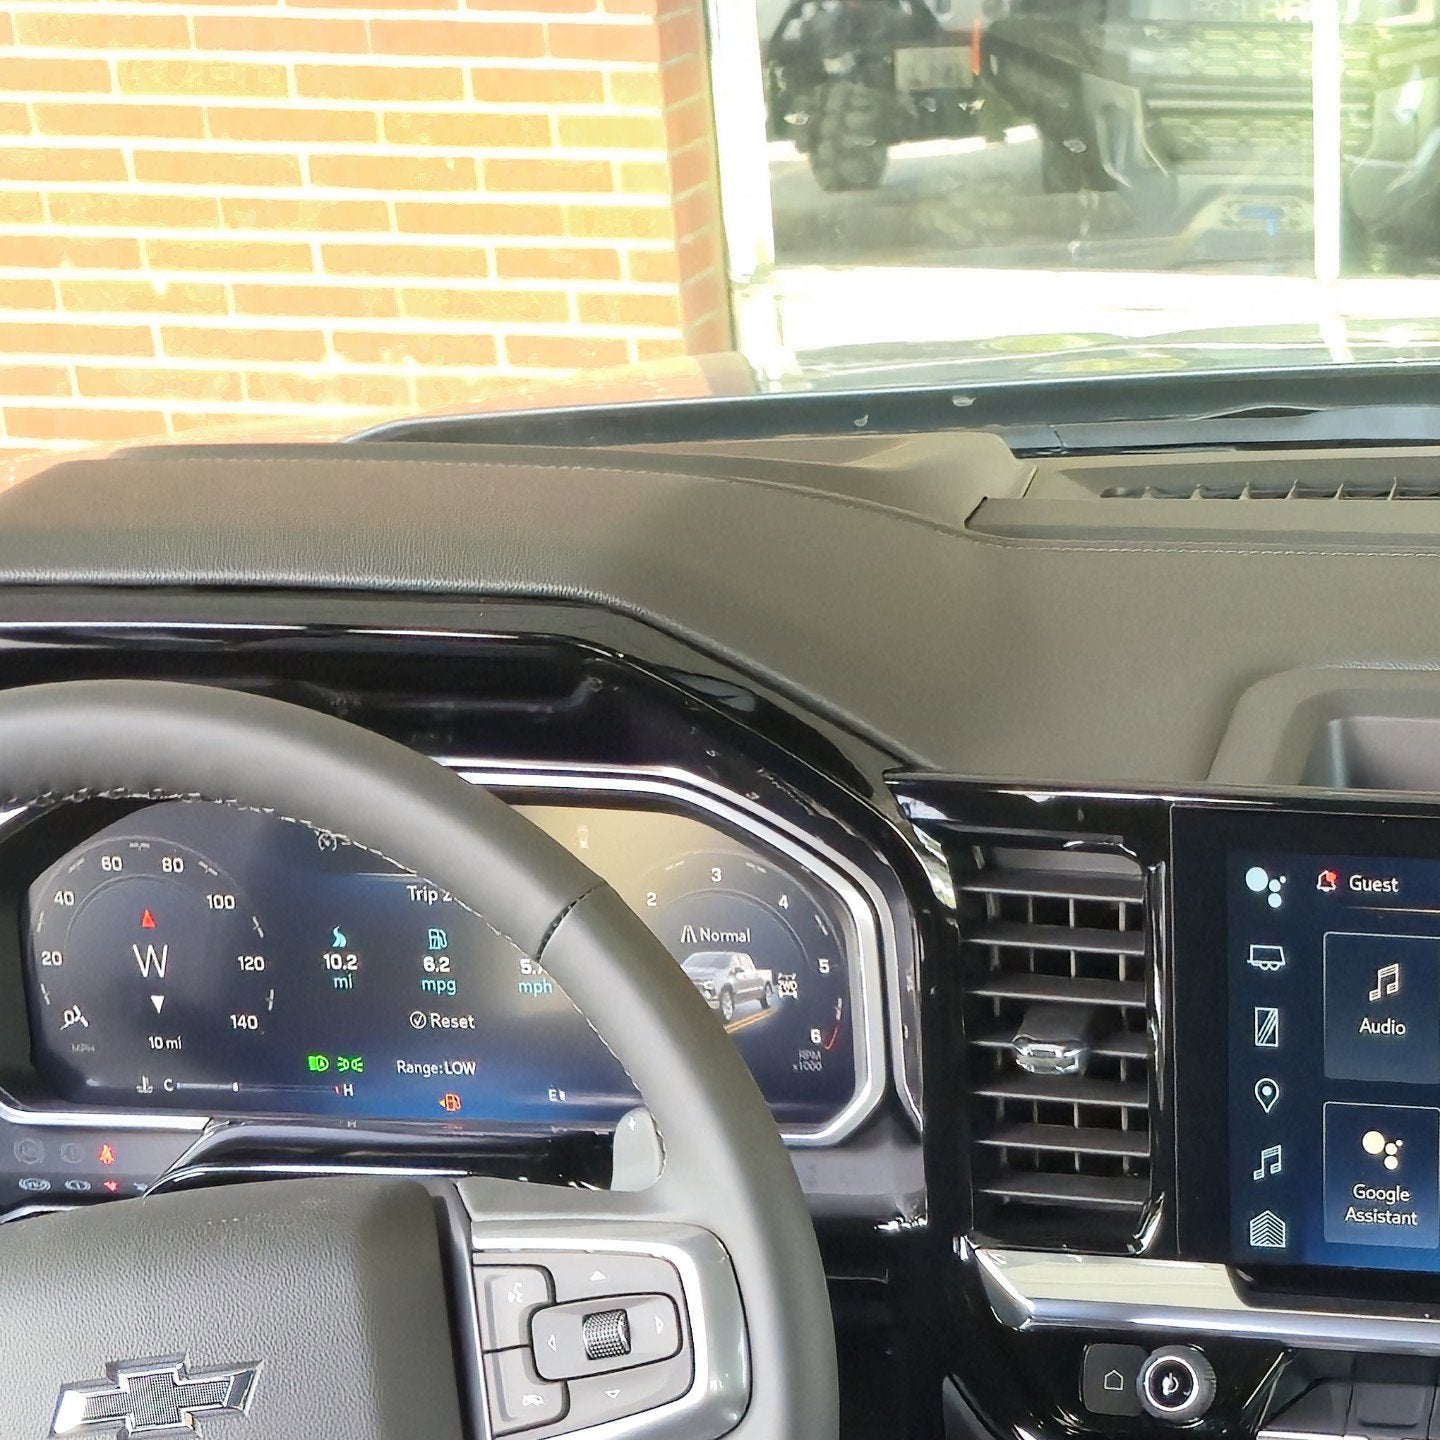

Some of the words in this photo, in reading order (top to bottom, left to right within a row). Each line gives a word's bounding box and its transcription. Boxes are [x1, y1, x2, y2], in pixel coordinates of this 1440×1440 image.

[101, 856, 122, 871] 60
[162, 857, 183, 873] 80
[711, 867, 721, 882] 3
[1349, 874, 1399, 892] Guest
[54, 890, 74, 905] 40
[207, 894, 235, 910] 100
[407, 885, 438, 905] Trip
[646, 892, 657, 907] 2
[778, 894, 789, 909] 4
[700, 928, 750, 943] Normal
[41, 951, 62, 966] 20
[133, 944, 168, 978] W
[238, 956, 265, 971] 120
[323, 953, 358, 970] 10.2
[423, 957, 450, 973] 6.2
[819, 959, 830, 974] 5
[334, 974, 353, 989] mi
[422, 977, 456, 996] mpg
[518, 977, 552, 997] mph
[230, 1014, 258, 1029] 140
[430, 1013, 475, 1029] Reset
[1359, 1018, 1406, 1036] Audio
[148, 1036, 163, 1049] 10
[165, 1035, 182, 1050] mi
[810, 1029, 821, 1043] 6
[799, 1050, 822, 1060] RPM
[164, 1079, 173, 1092] C
[344, 1084, 354, 1096] H
[548, 1089, 558, 1101] E
[1353, 1184, 1410, 1203] Google
[1345, 1207, 1417, 1226] Assistant
